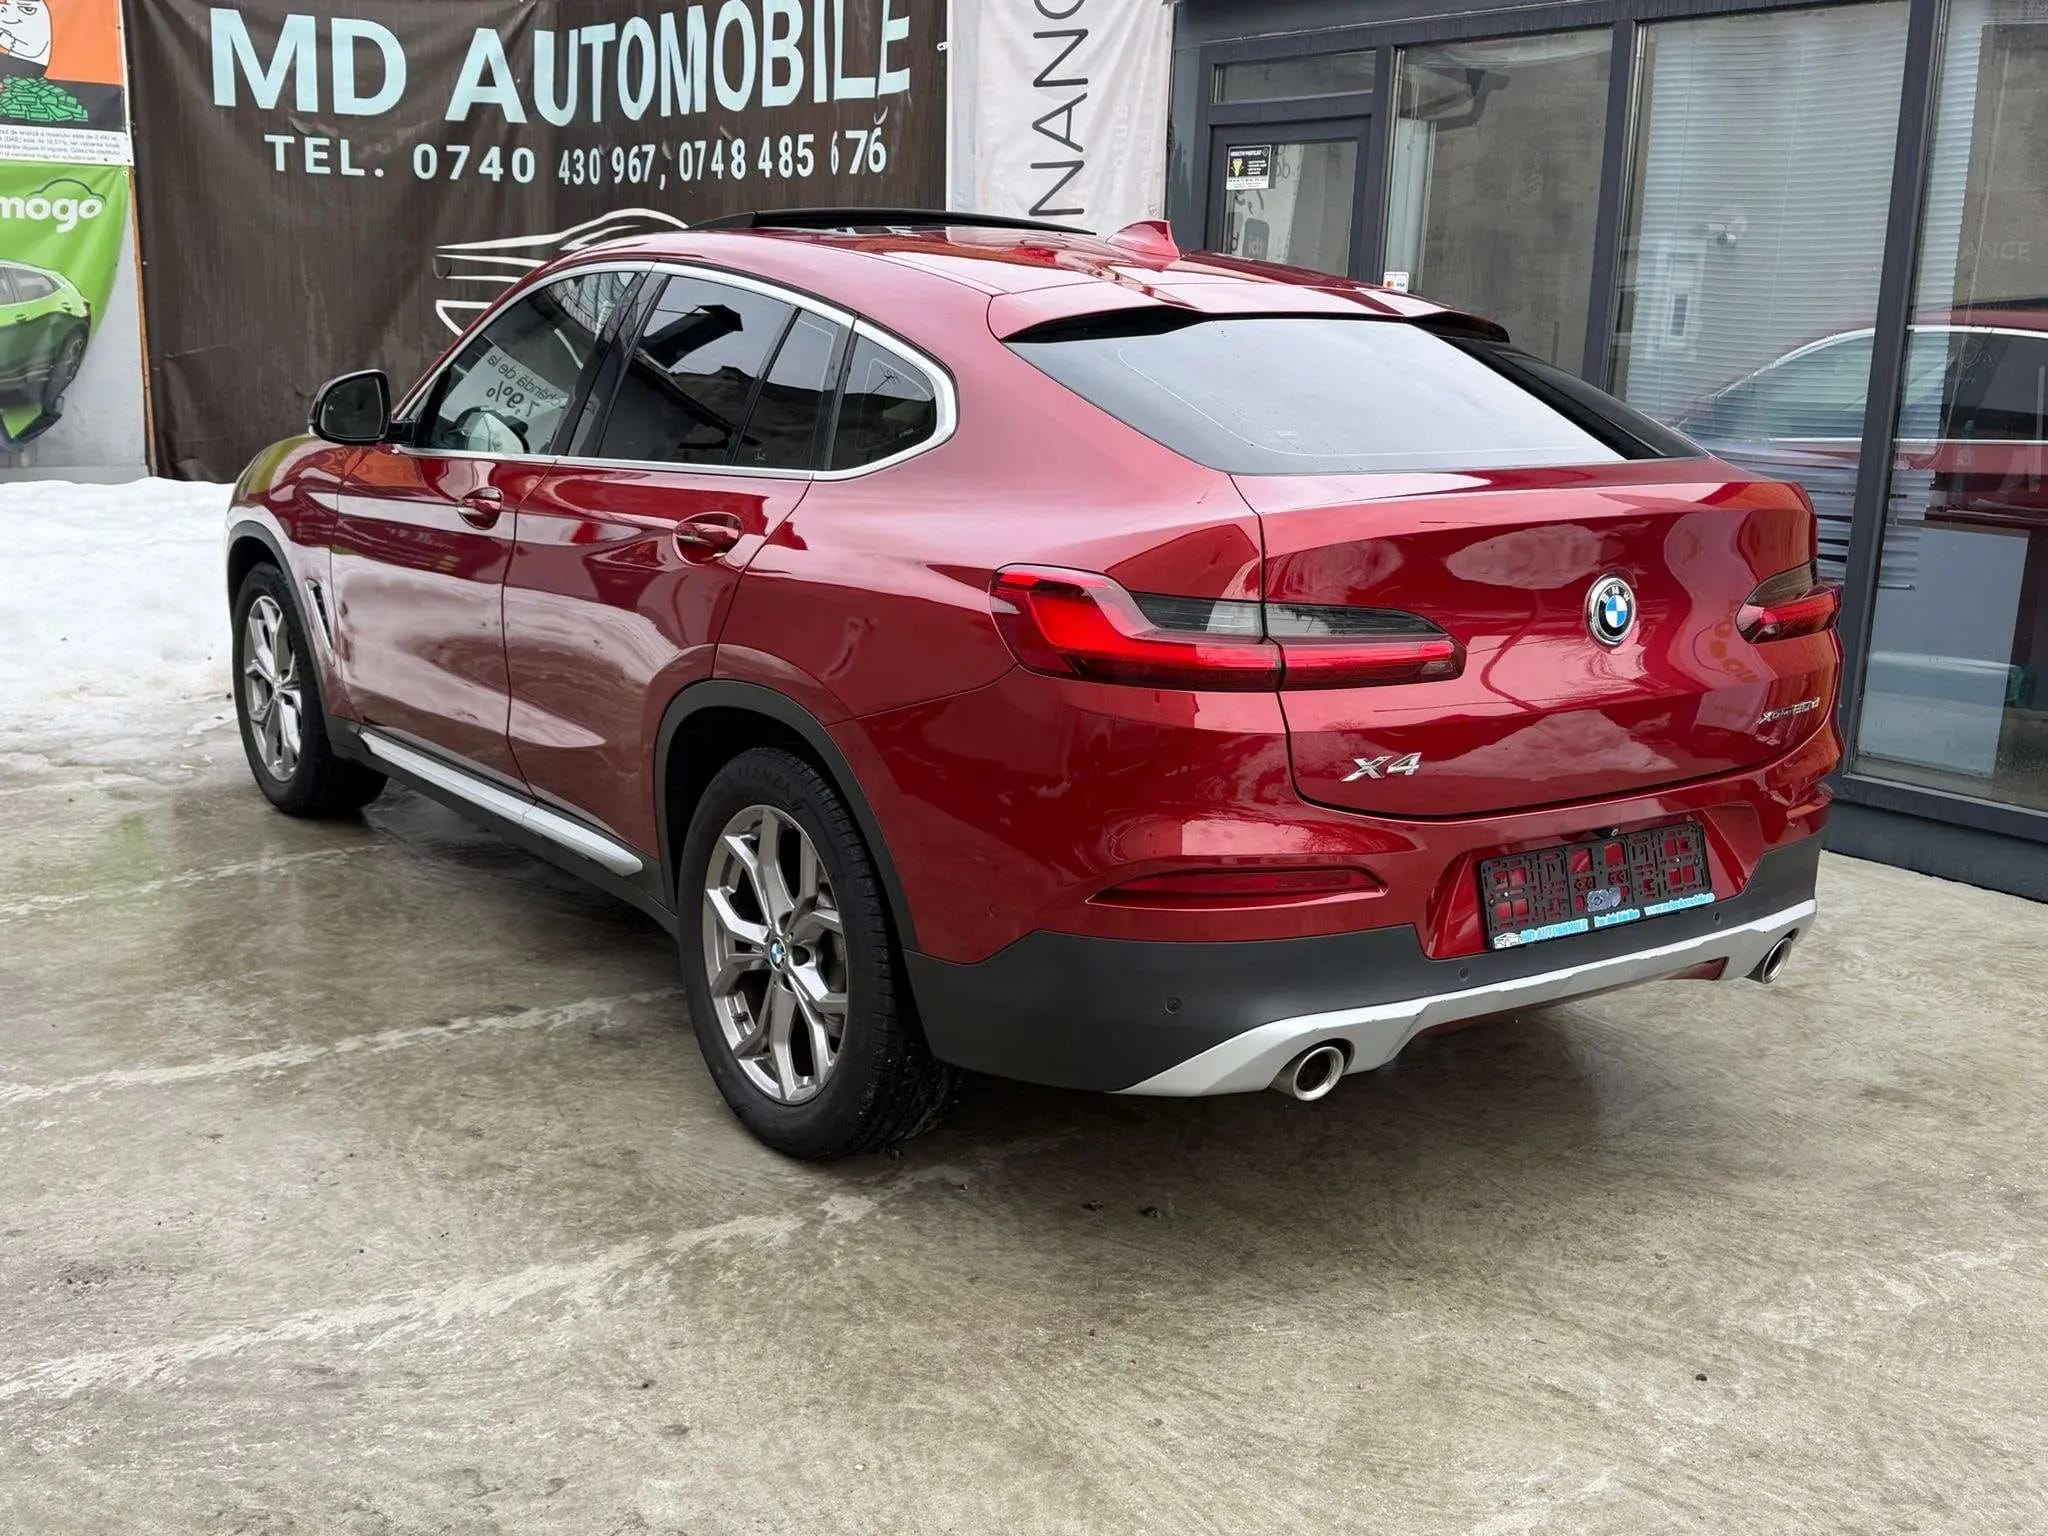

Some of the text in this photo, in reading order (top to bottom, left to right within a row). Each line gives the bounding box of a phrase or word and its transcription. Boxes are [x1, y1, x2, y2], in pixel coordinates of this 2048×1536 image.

[210, 0, 910, 127] MD AUTOMOBILE
[264, 134, 385, 178] TEL.
[413, 143, 536, 184] 0740
[558, 147, 600, 186] 430
[611, 144, 666, 190] 967,
[679, 138, 746, 181] 0748
[758, 134, 814, 179] 485
[1340, 752, 1422, 782] X4
